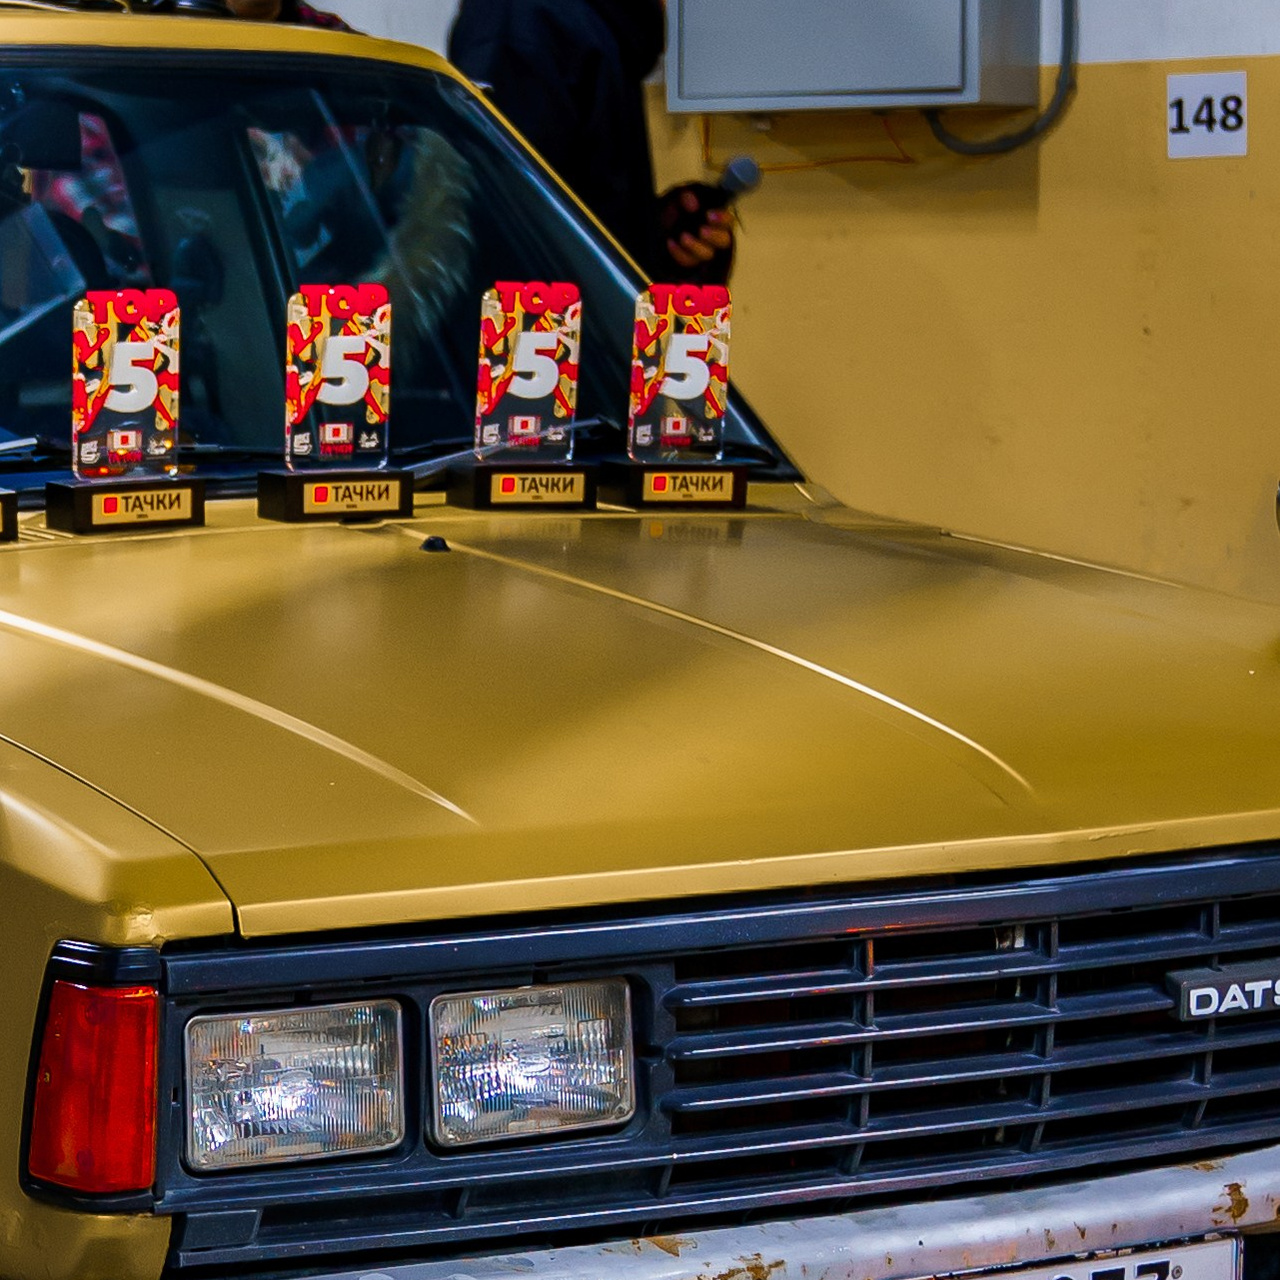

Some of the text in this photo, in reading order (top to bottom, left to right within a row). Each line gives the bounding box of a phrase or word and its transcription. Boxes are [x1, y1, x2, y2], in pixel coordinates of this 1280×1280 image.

[1168, 95, 1244, 135] 148
[85, 288, 178, 325] TOP
[298, 283, 390, 320] TOP
[494, 280, 580, 315] TOP
[648, 284, 730, 317] TOP
[103, 341, 159, 414] 5
[315, 335, 370, 406] 5
[507, 331, 559, 399] 5
[658, 333, 710, 400] 5
[331, 484, 390, 503] ТАЧКИ
[518, 476, 575, 494] ТАЧКИ
[670, 475, 724, 492] ТАЧКИ
[121, 493, 181, 512] ТАЧКИ
[1189, 979, 1280, 1016] DAT
